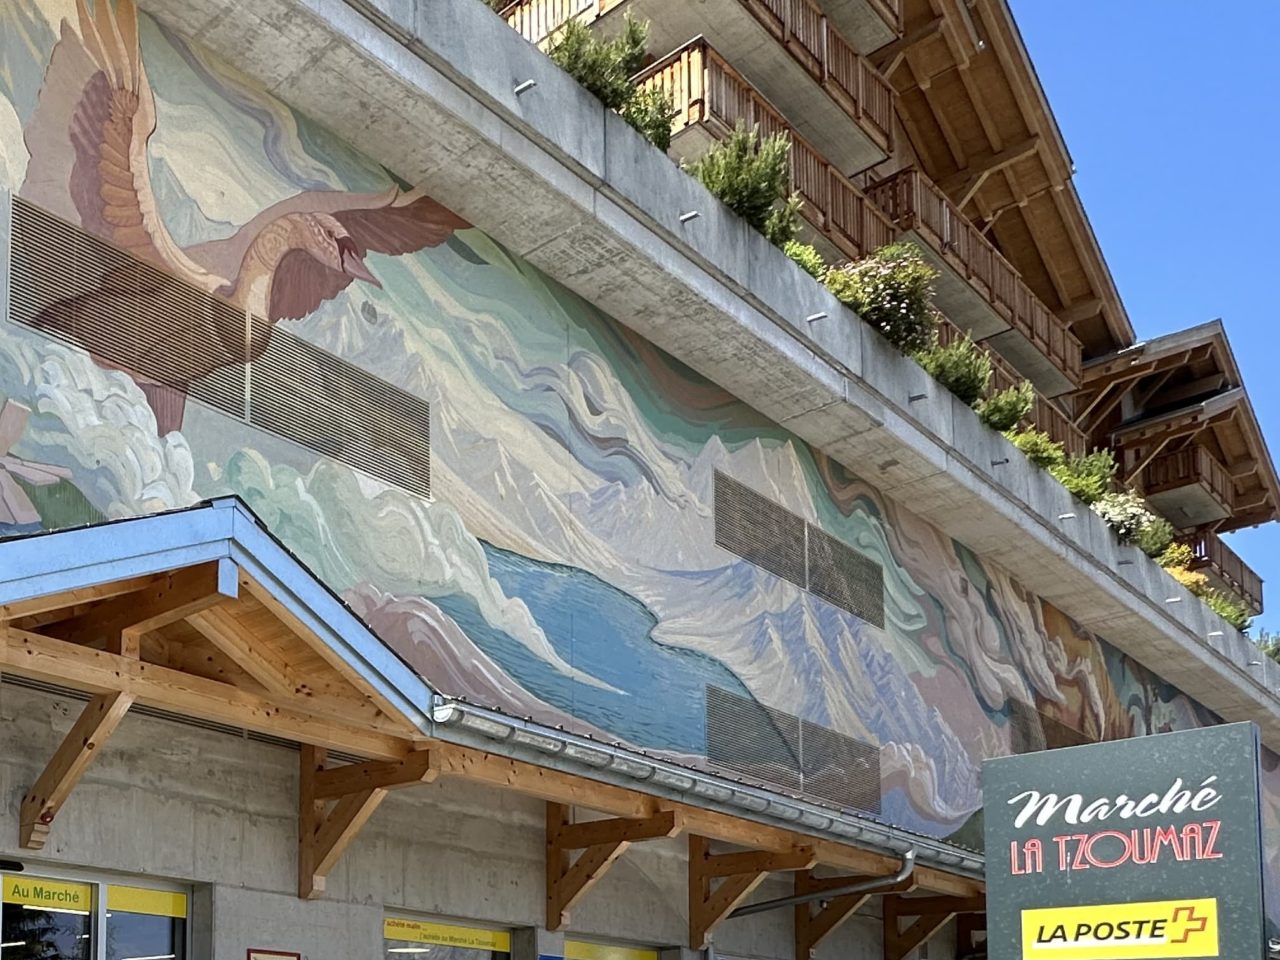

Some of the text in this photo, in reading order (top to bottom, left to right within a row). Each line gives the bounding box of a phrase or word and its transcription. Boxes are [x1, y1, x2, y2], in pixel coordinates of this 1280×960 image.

[1007, 775, 1223, 829] Marché
[1010, 820, 1224, 875] LA TZOUMAZ
[11, 884, 80, 903] Au Marché
[1036, 919, 1168, 943] LA POSTE
